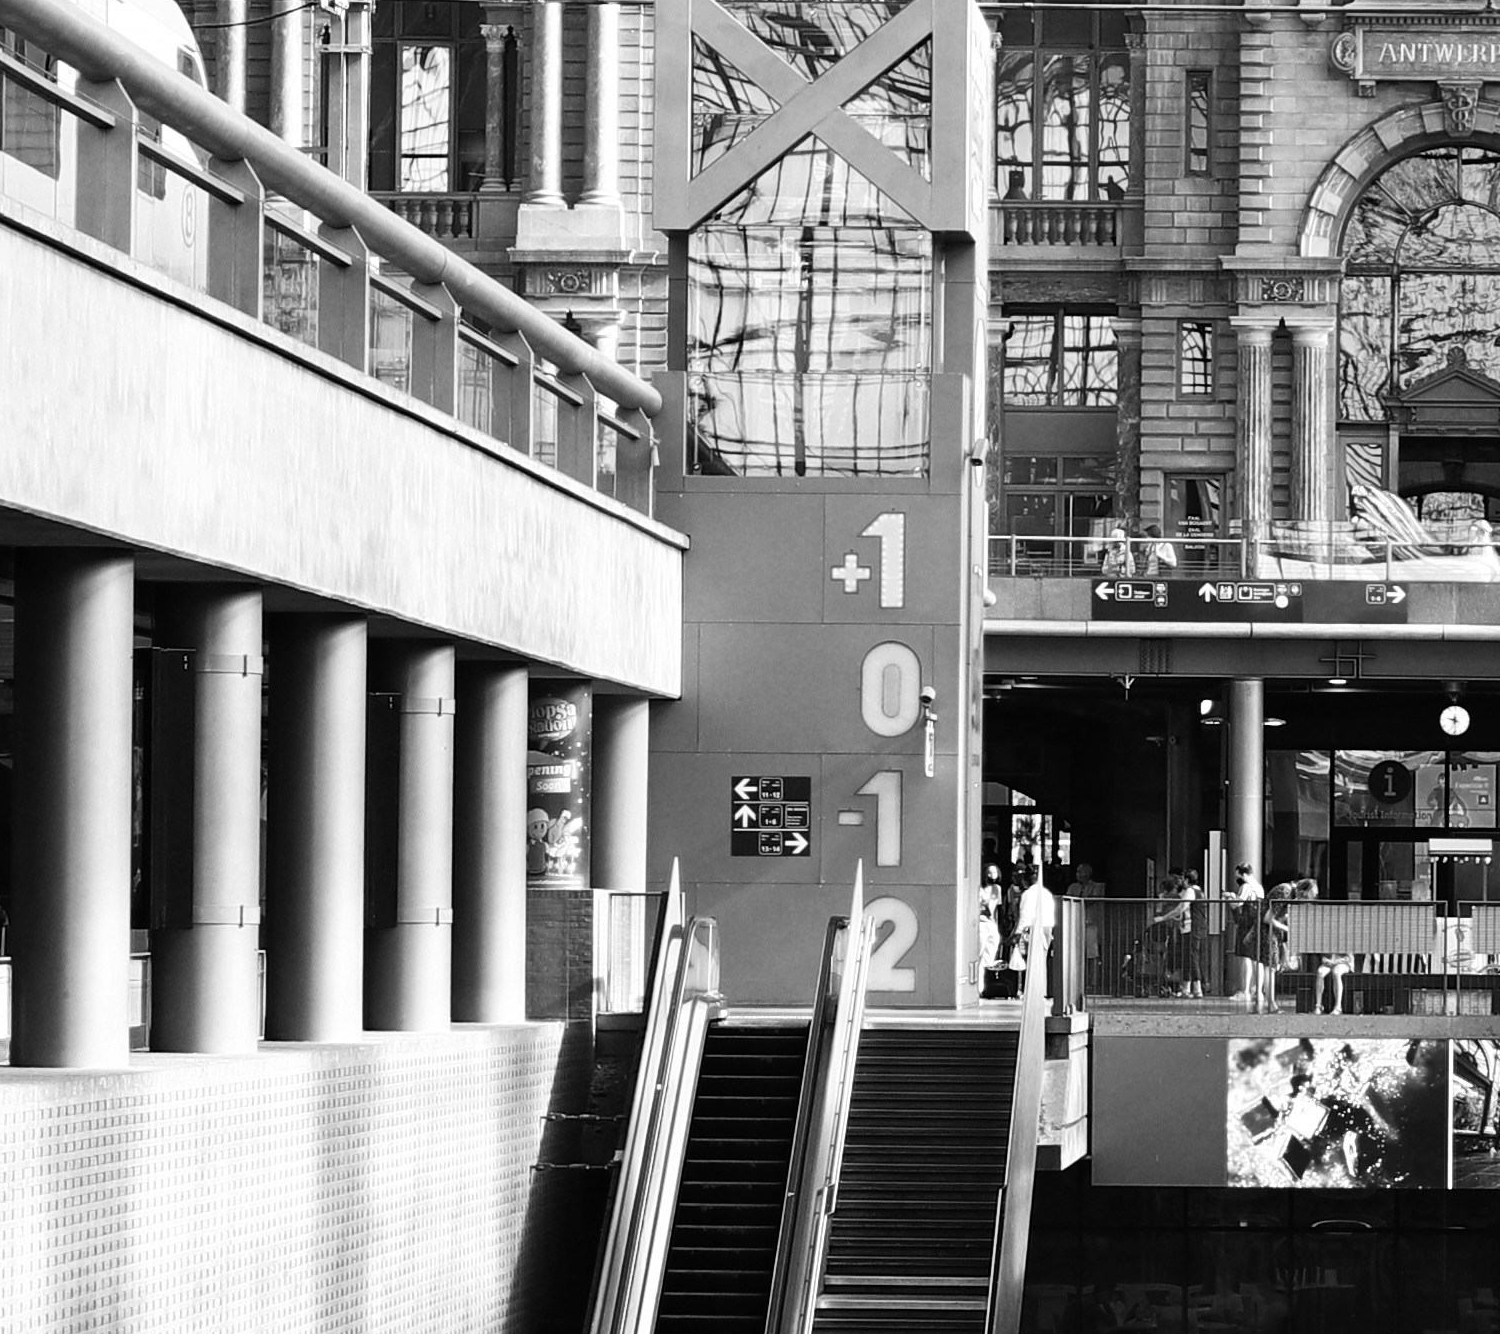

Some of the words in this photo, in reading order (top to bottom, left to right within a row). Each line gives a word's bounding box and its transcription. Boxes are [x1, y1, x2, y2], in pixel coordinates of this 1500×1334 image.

[859, 639, 923, 738] 0
[528, 703, 577, 720] lopsa
[528, 764, 572, 779] pening
[535, 781, 562, 791] Soon
